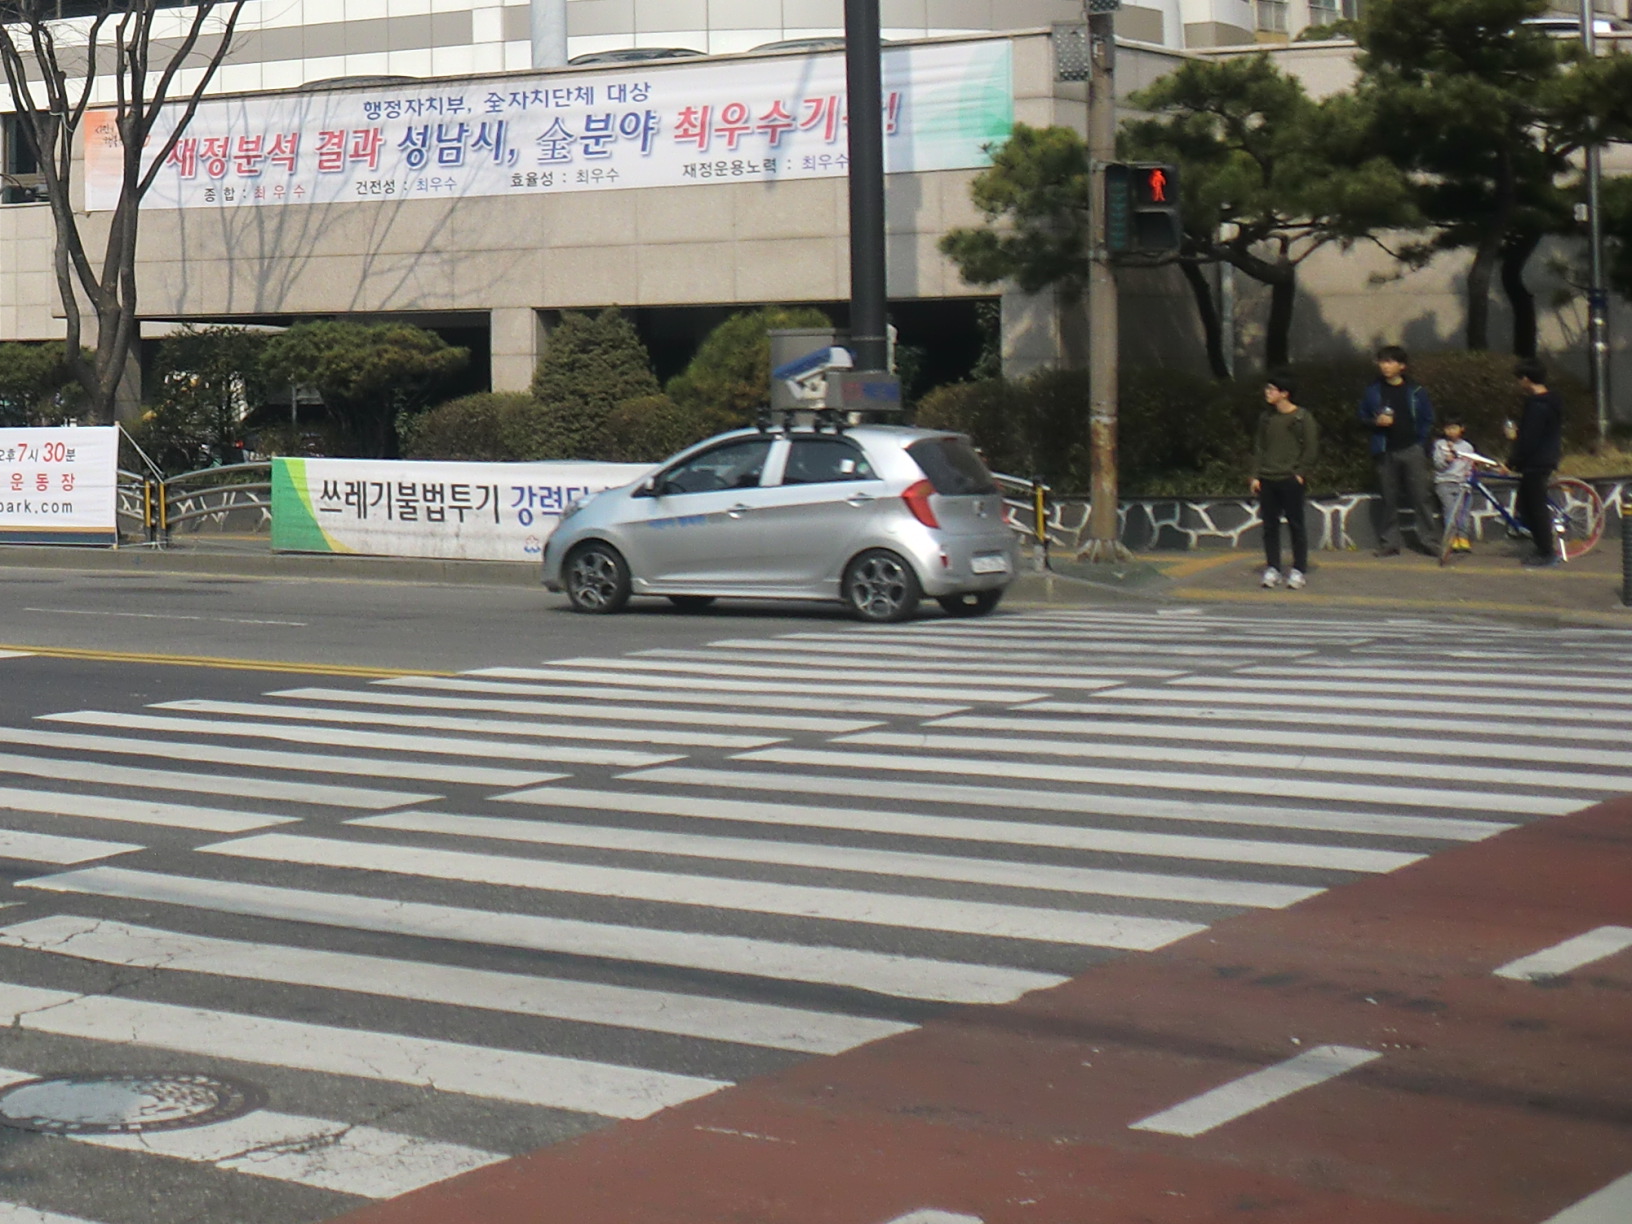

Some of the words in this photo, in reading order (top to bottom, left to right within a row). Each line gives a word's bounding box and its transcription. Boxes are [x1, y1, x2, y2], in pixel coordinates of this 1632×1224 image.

[608, 81, 652, 103] 대상
[167, 130, 299, 179] 재정분석
[315, 127, 385, 173] 결과
[511, 171, 554, 189] 효율성
[575, 166, 620, 186] 최우수
[682, 157, 777, 179] 재정운용노력
[356, 178, 396, 196] 건전성
[416, 176, 458, 193] 최우수
